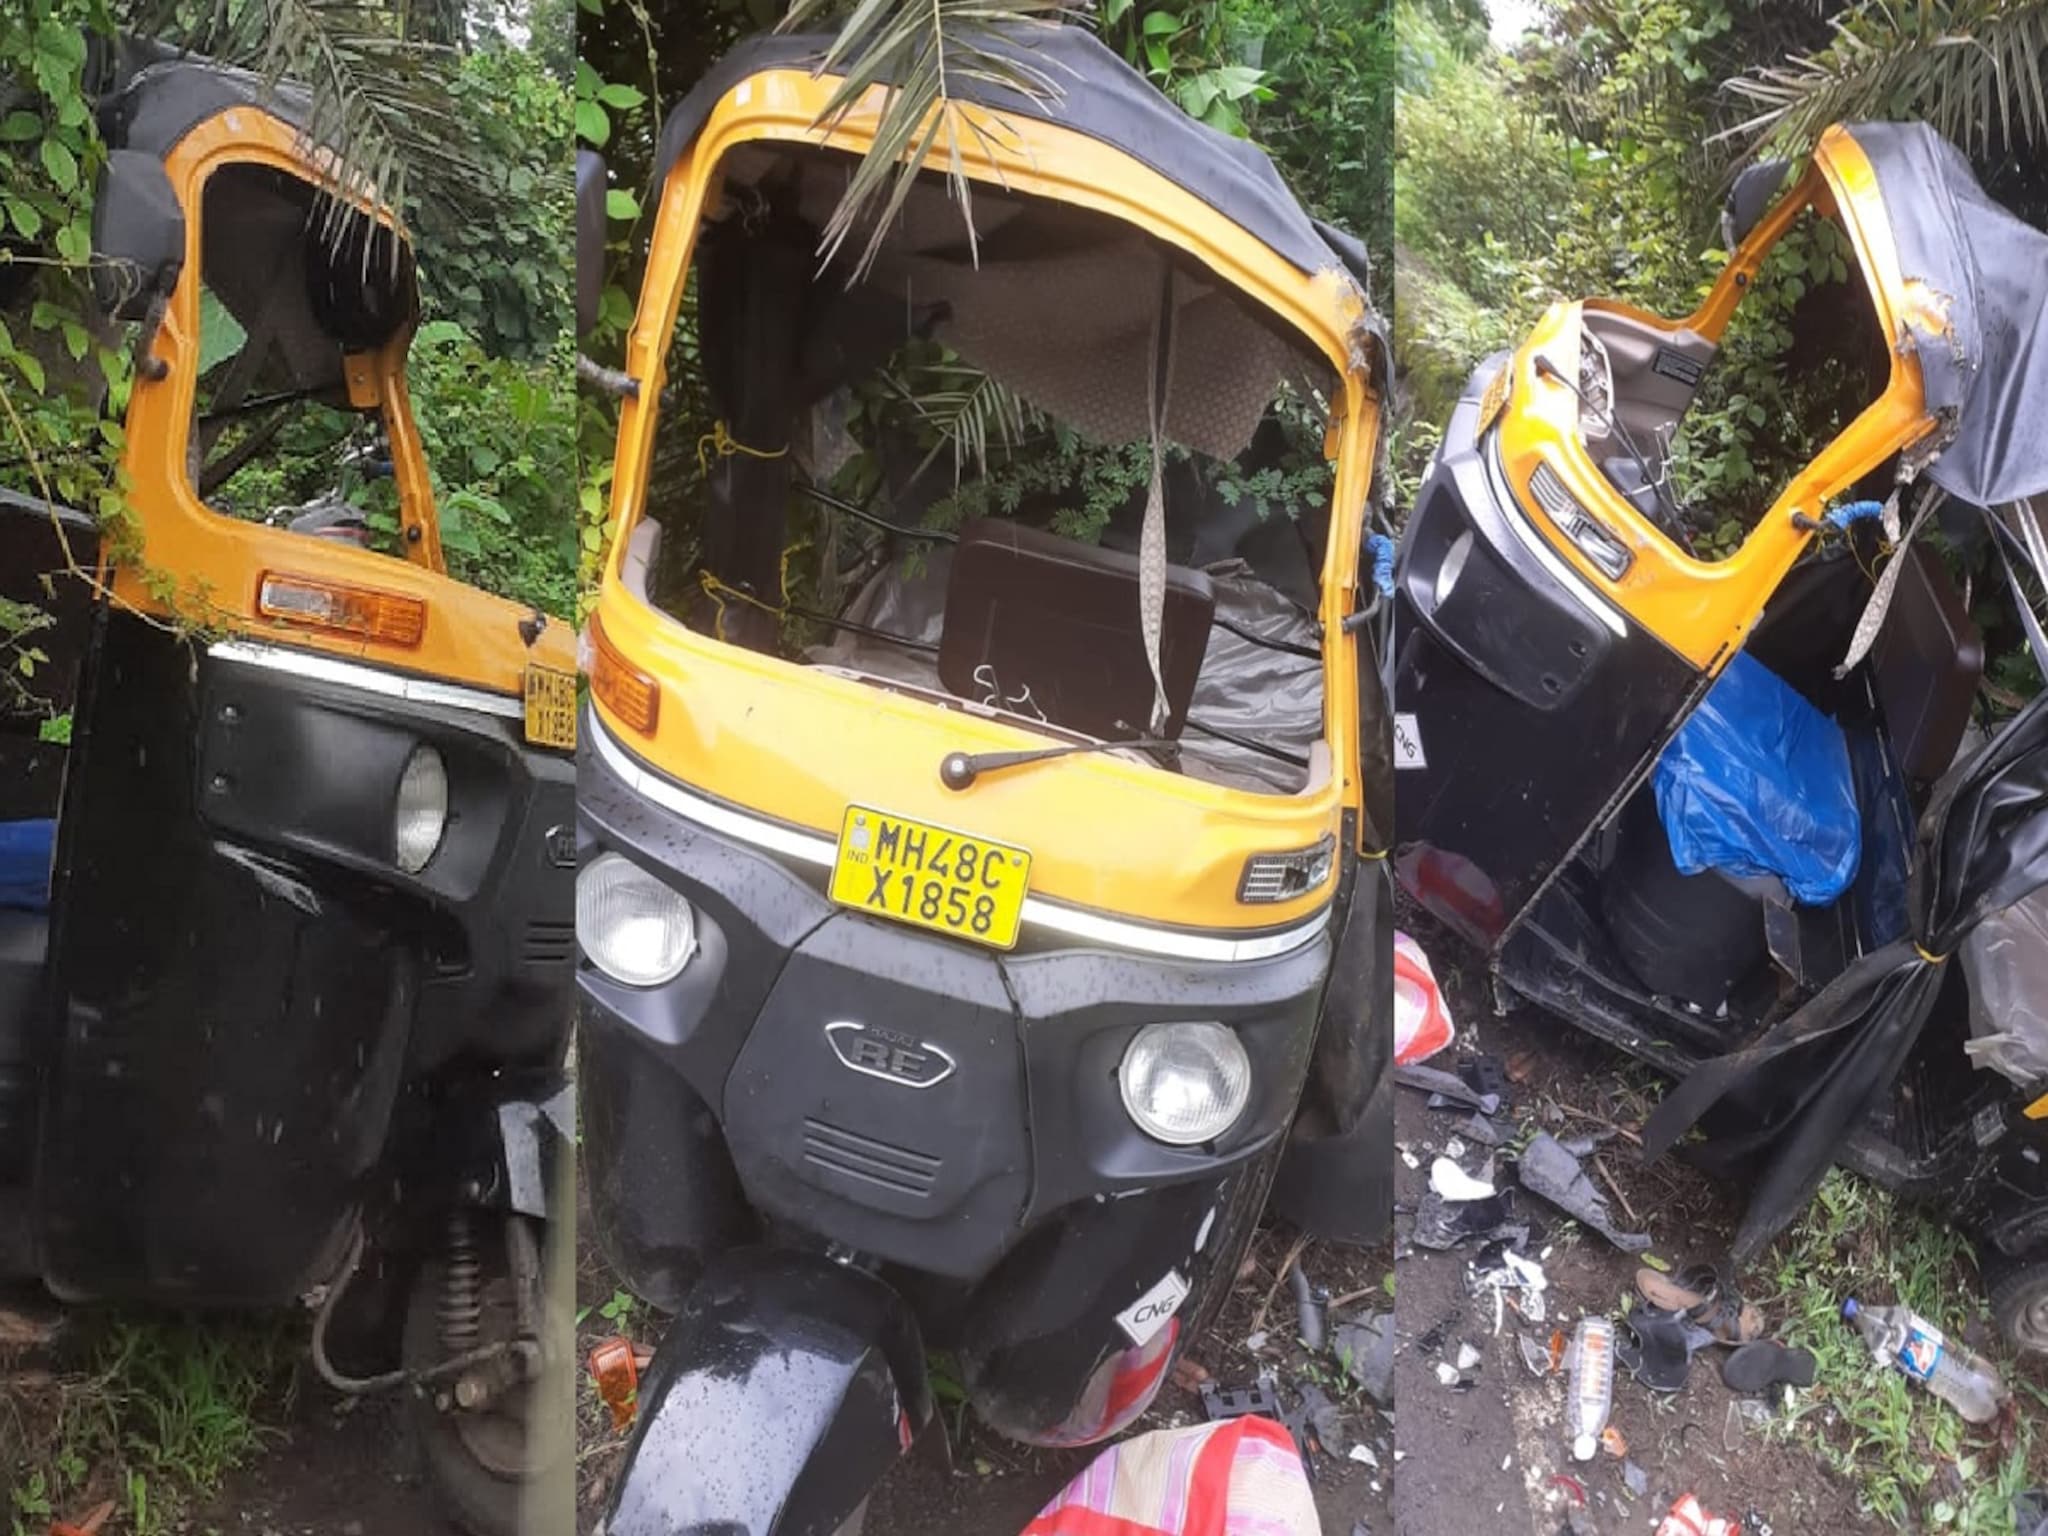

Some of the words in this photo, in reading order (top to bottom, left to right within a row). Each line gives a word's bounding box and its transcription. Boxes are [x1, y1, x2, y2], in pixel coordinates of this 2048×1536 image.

[1395, 724, 1417, 758] CNG
[847, 849, 869, 864] IND
[875, 820, 1005, 889] MH48C
[866, 865, 995, 934] X1858
[850, 1037, 927, 1080] RE
[1133, 1295, 1176, 1323] CNG
